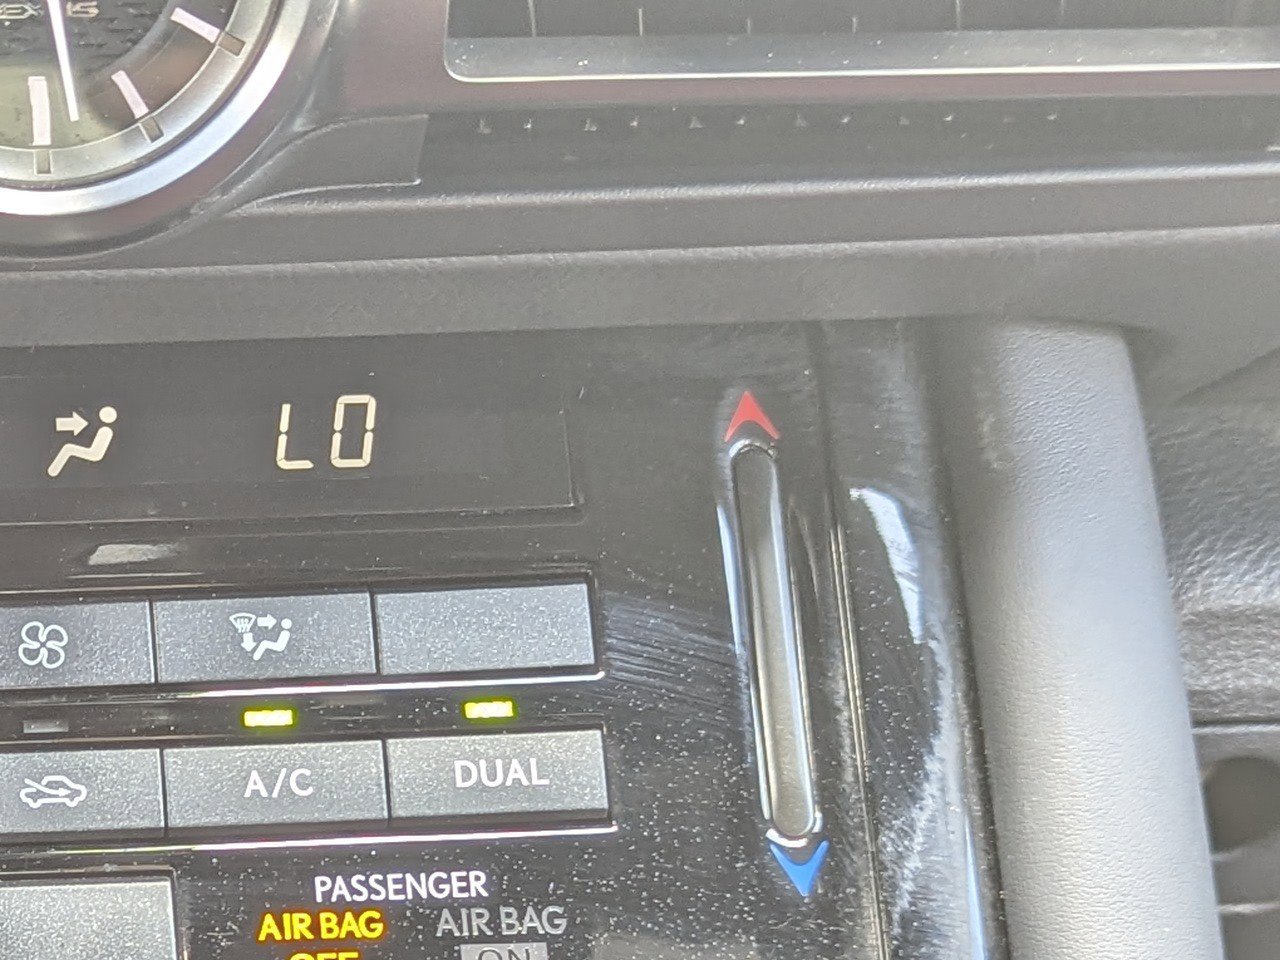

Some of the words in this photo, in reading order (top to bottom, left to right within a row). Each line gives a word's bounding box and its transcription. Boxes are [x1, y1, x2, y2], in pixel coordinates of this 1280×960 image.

[244, 768, 314, 799] A/C
[454, 757, 550, 788] DUAL
[313, 870, 489, 903] PASSENGER
[257, 911, 315, 942] AIR
[320, 911, 384, 940] BAG
[435, 907, 491, 938] AIR
[498, 905, 568, 936] BAG
